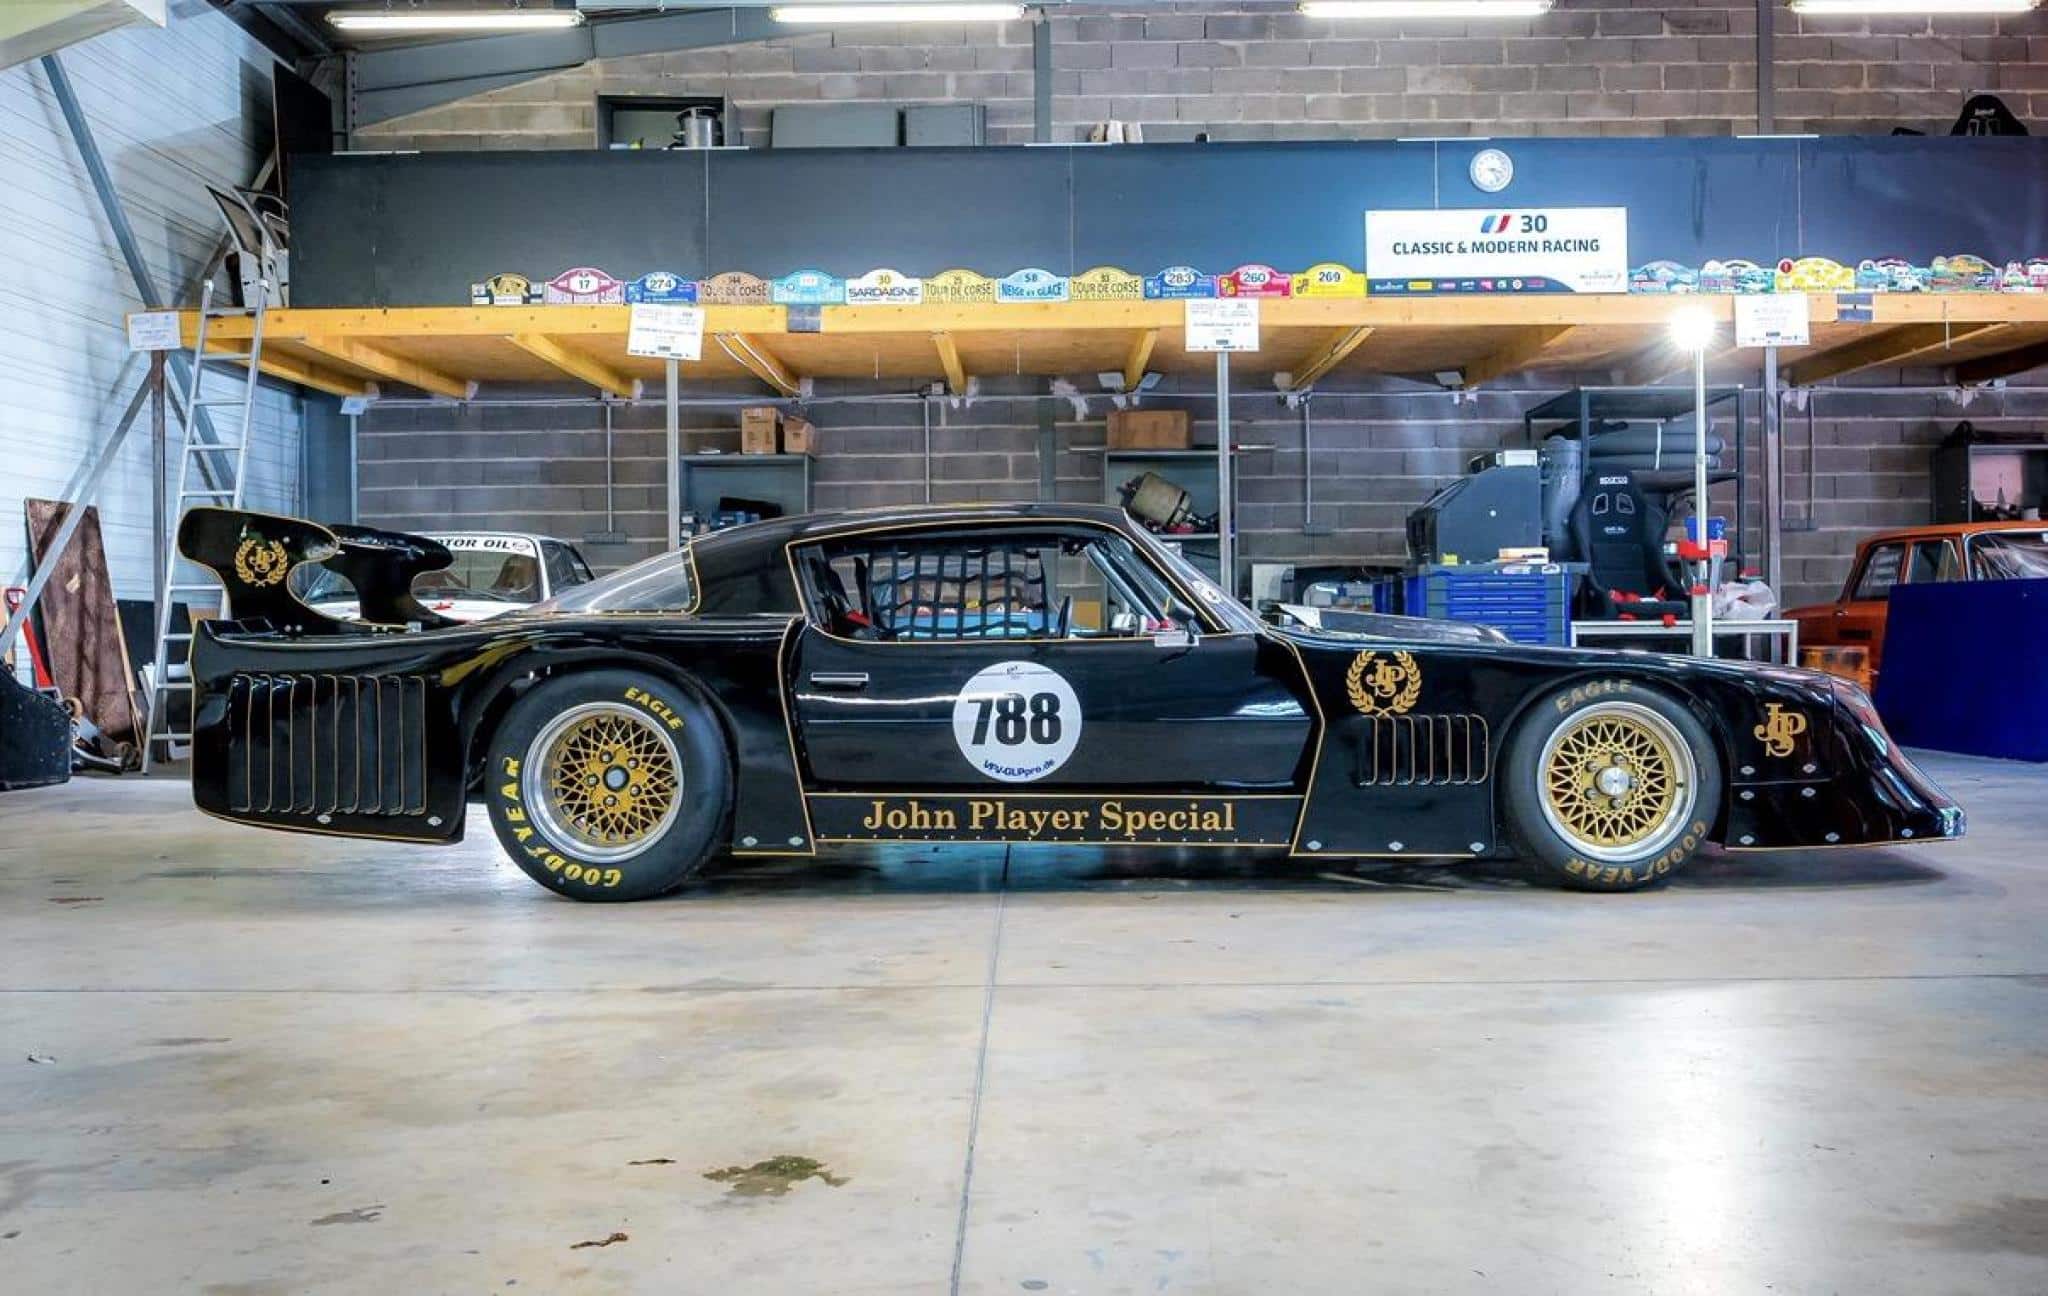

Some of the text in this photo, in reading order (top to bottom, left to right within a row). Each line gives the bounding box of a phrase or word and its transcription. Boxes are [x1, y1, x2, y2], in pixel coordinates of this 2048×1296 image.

[1521, 215, 1548, 233] 30
[1392, 238, 1601, 256] CLASSIC & MODERN RACING
[878, 274, 892, 284] 30
[1167, 272, 1192, 284] 283
[1243, 271, 1266, 283] 260
[1317, 271, 1341, 283] 269
[578, 279, 590, 289] 17
[650, 279, 673, 289] 274
[926, 281, 992, 297] TOUR DE CORSE
[1072, 279, 1139, 294] TOUR DE CORSE
[848, 286, 919, 298] SARDAIGNE
[484, 539, 510, 550] OIL
[1554, 678, 1633, 714] EAGLE
[624, 687, 685, 730] EAGLE
[967, 692, 1062, 745] 788
[863, 800, 1235, 837] John Player Special
